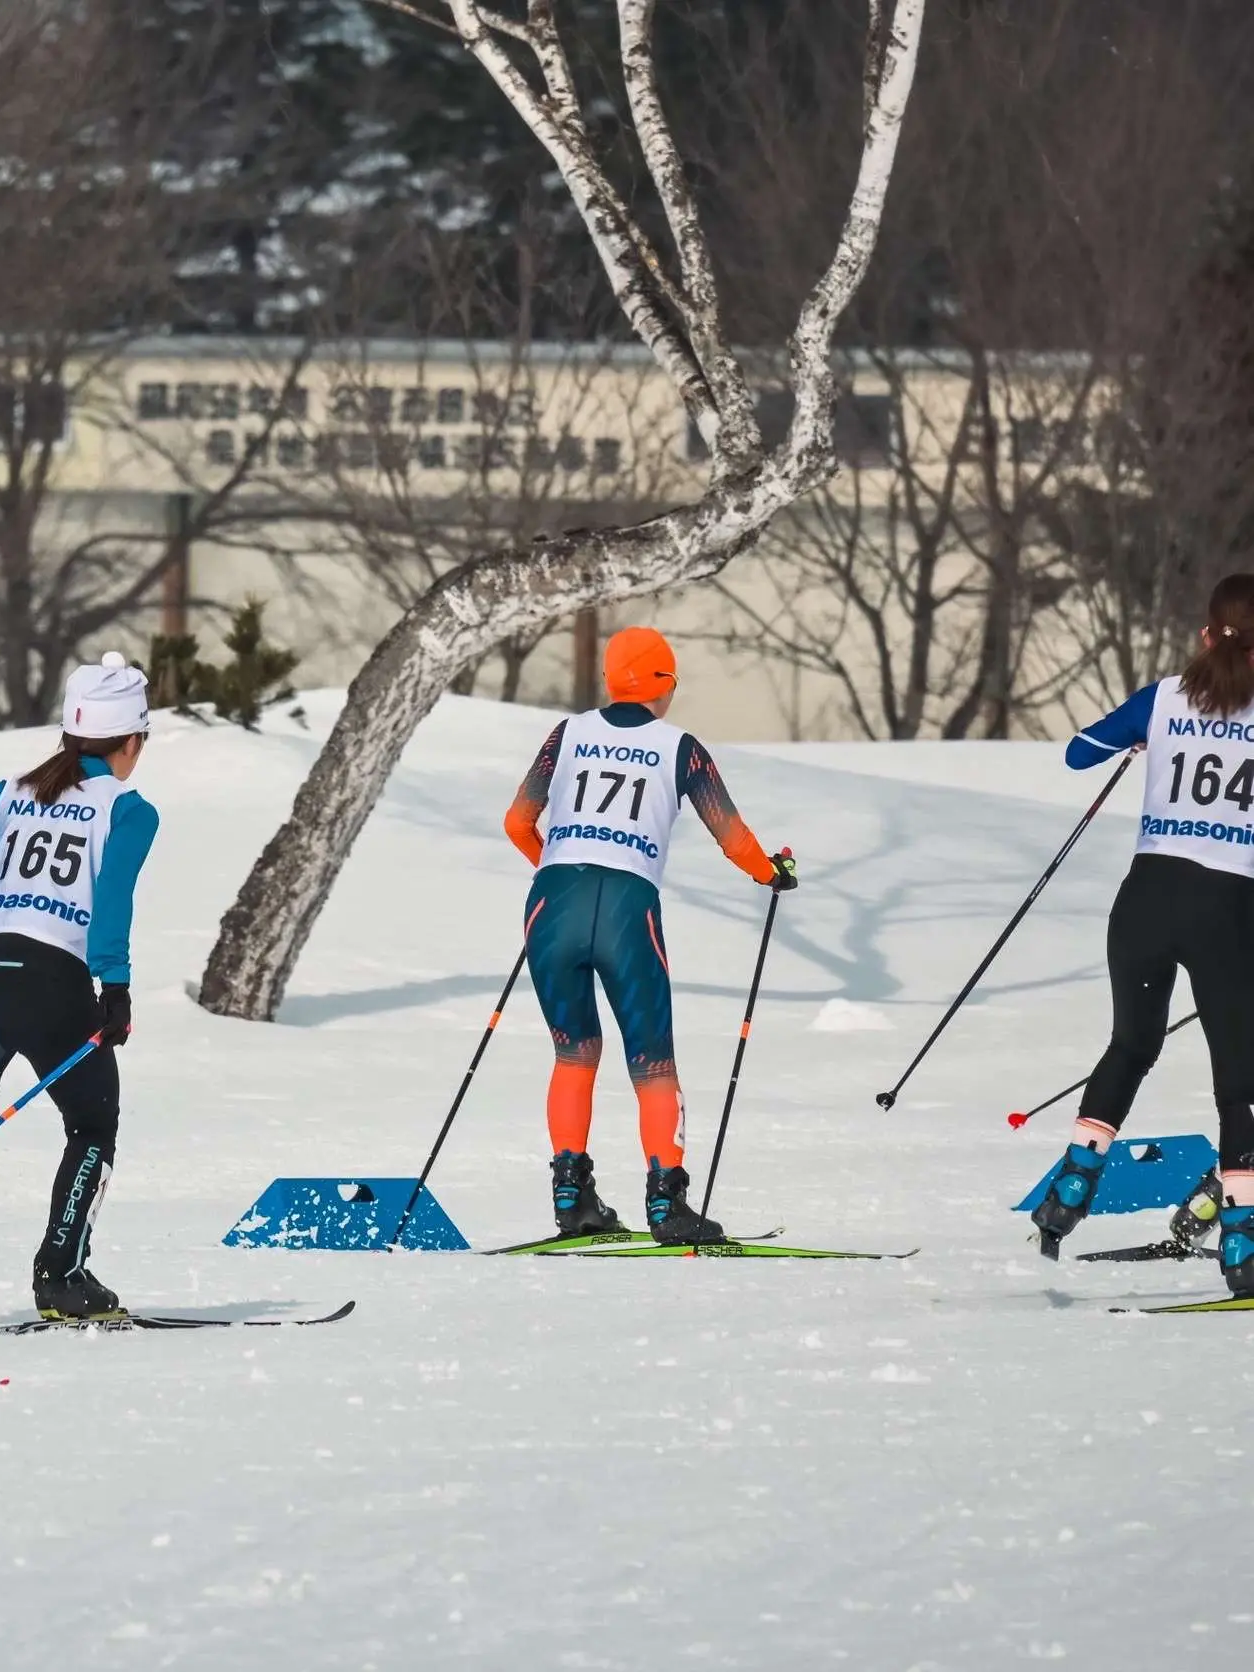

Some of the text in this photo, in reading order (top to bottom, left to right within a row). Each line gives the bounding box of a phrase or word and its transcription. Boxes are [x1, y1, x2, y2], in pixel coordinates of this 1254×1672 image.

[575, 744, 660, 767] NAYORO
[573, 770, 647, 821] 171
[1169, 752, 1254, 812] 164
[7, 799, 96, 822] NAYORO
[0, 829, 87, 886] 165
[52, 1146, 101, 1248] LA SPORTIVA
[591, 1234, 632, 1245] FISCHER
